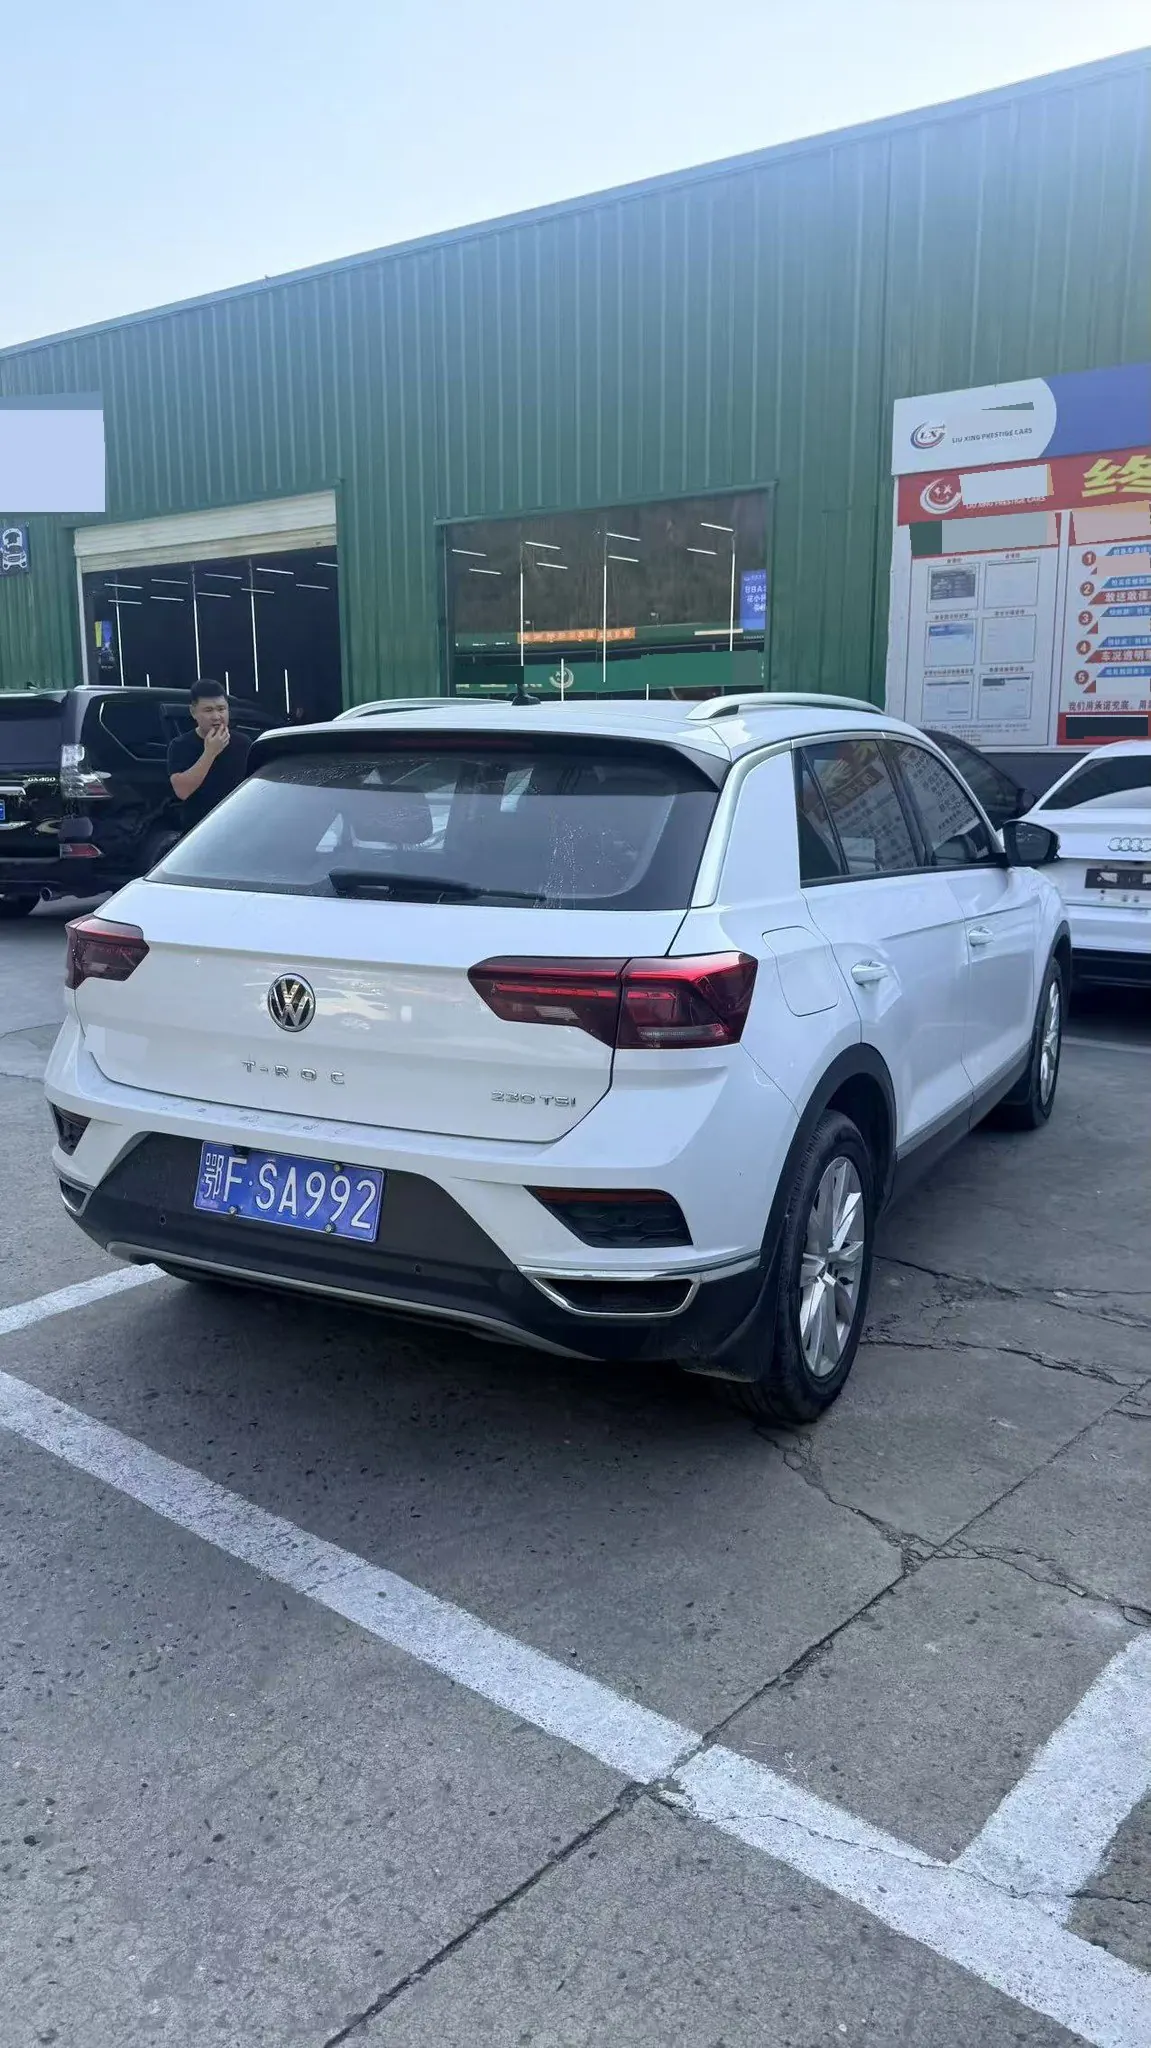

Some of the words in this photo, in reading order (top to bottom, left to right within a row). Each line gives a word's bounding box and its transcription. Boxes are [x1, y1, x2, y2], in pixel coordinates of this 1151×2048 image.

[963, 434, 981, 442] XING
[981, 429, 1013, 440] PRESTIGE
[1013, 427, 1033, 436] CARS
[491, 1091, 535, 1105] 230
[539, 1095, 576, 1108] TSI
